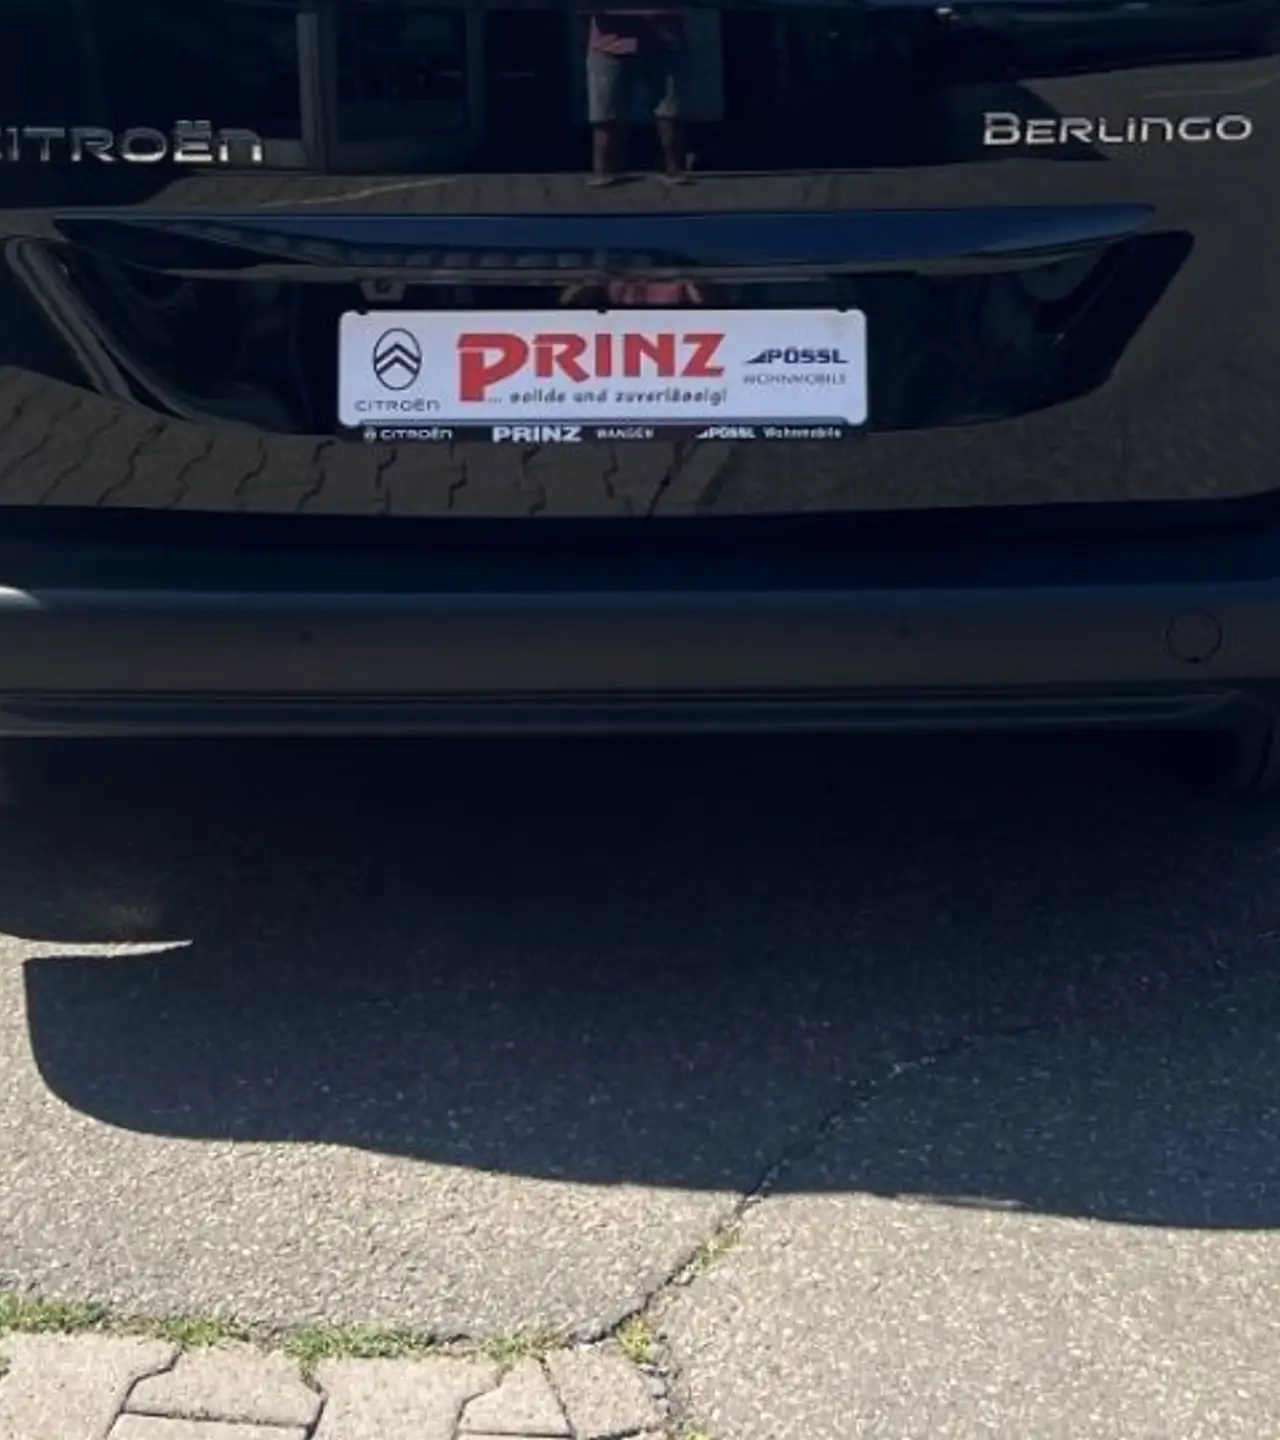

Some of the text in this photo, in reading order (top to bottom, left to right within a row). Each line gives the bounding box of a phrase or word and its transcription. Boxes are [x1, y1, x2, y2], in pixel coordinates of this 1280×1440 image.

[982, 111, 1253, 146] BERLINGO
[764, 346, 849, 365] PÖSSL
[457, 332, 727, 402] PRINZ
[573, 388, 608, 404] und
[491, 426, 582, 443] PRINZ
